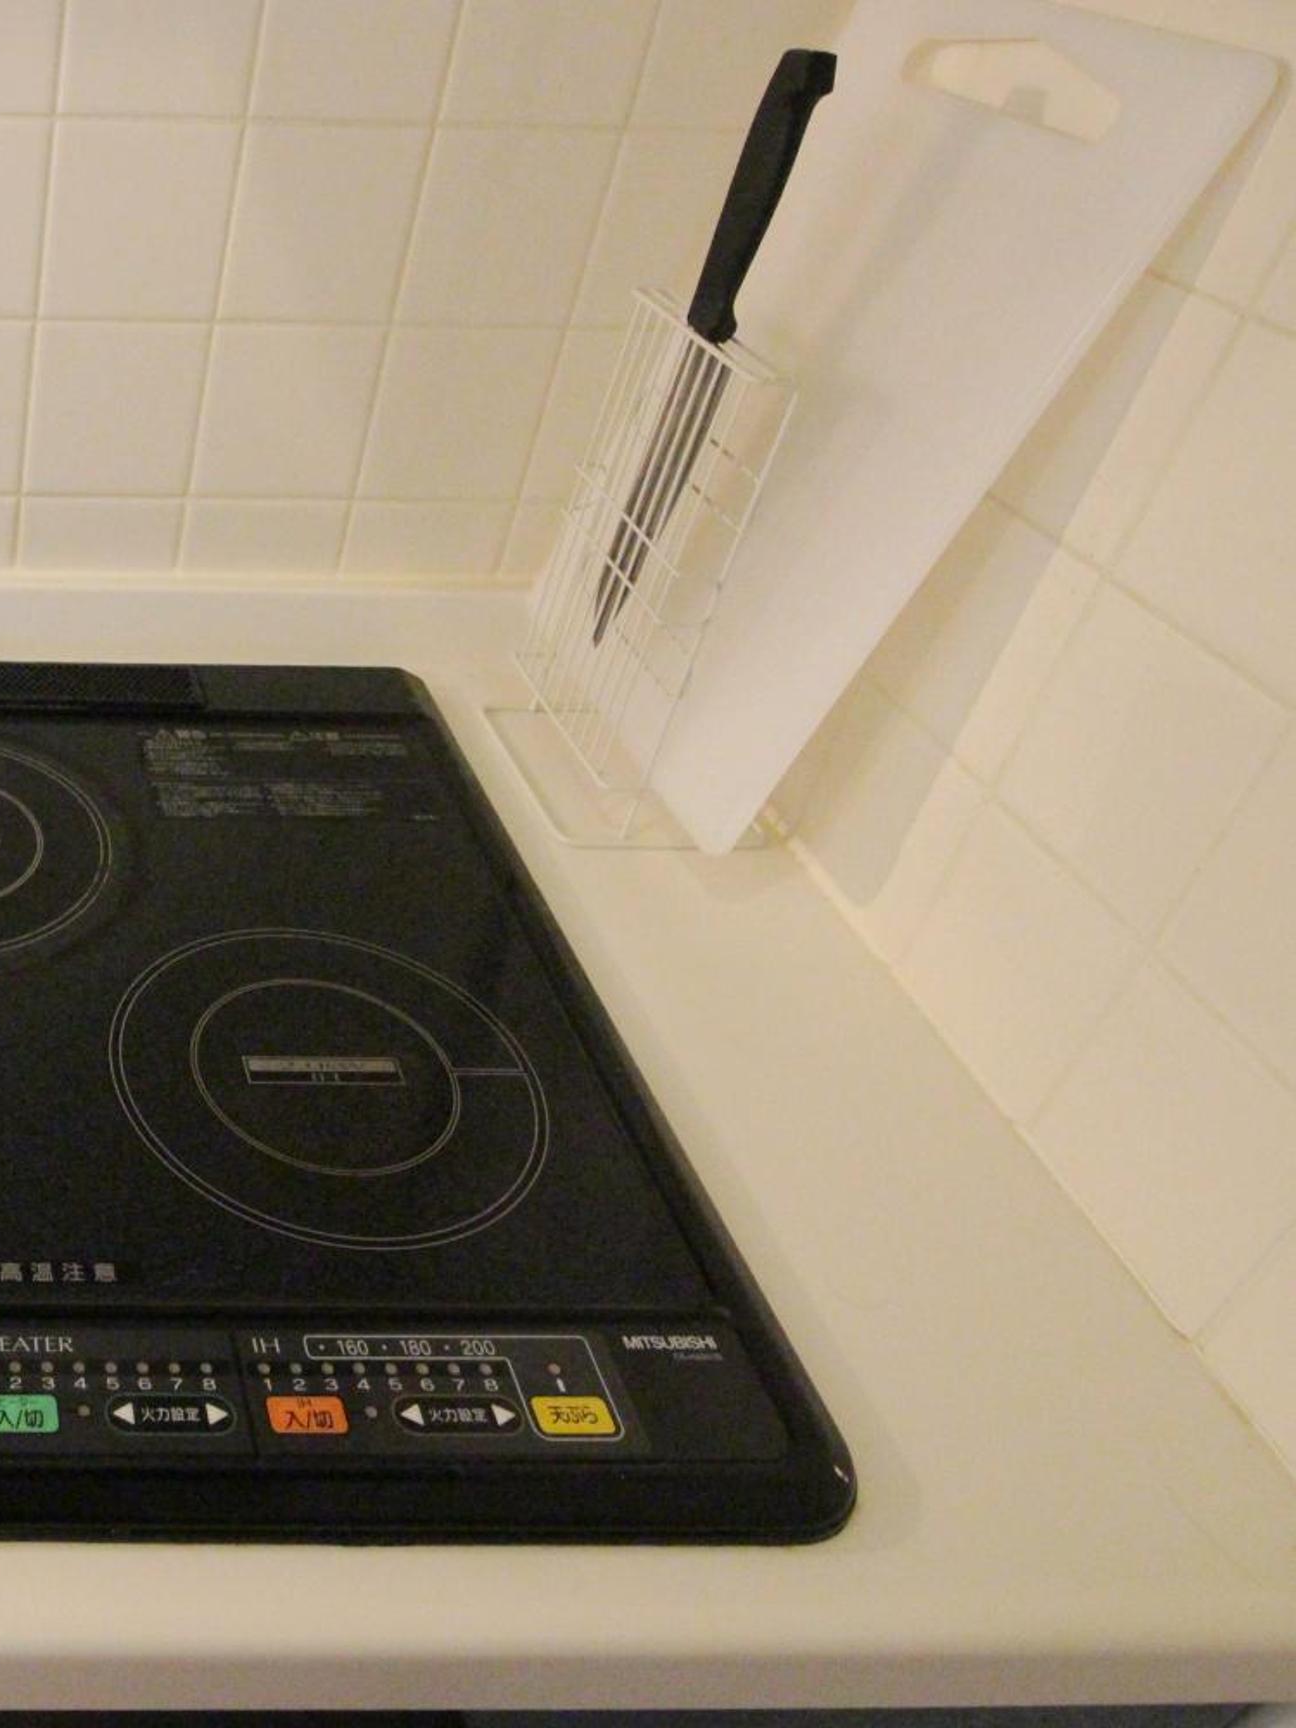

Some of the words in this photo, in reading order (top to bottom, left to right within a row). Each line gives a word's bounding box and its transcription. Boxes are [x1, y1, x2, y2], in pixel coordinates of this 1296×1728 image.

[0, 1261, 117, 1283] 高温注意
[252, 1337, 281, 1354] IH
[336, 1339, 370, 1356] 160
[399, 1339, 433, 1356] 180
[460, 1339, 497, 1356] 200
[621, 1334, 719, 1351] MITSUBISHI
[9, 1377, 23, 1391] 2
[41, 1377, 55, 1391] 3
[73, 1377, 88, 1391] 4
[106, 1377, 120, 1391] 5
[138, 1377, 153, 1391] 6
[170, 1377, 183, 1391] 7
[202, 1377, 217, 1391] 8
[263, 1378, 273, 1392] 1
[292, 1378, 306, 1392] 2
[324, 1378, 339, 1392] 3
[356, 1378, 371, 1392] 4
[388, 1378, 403, 1392] 5
[420, 1378, 435, 1392] 6
[453, 1378, 466, 1392] 7
[484, 1378, 499, 1392] 8
[140, 1406, 201, 1423] 火力設定
[285, 1410, 334, 1429] 入/切
[428, 1406, 488, 1424] 火力設定
[546, 1404, 600, 1425] 天ぷら
